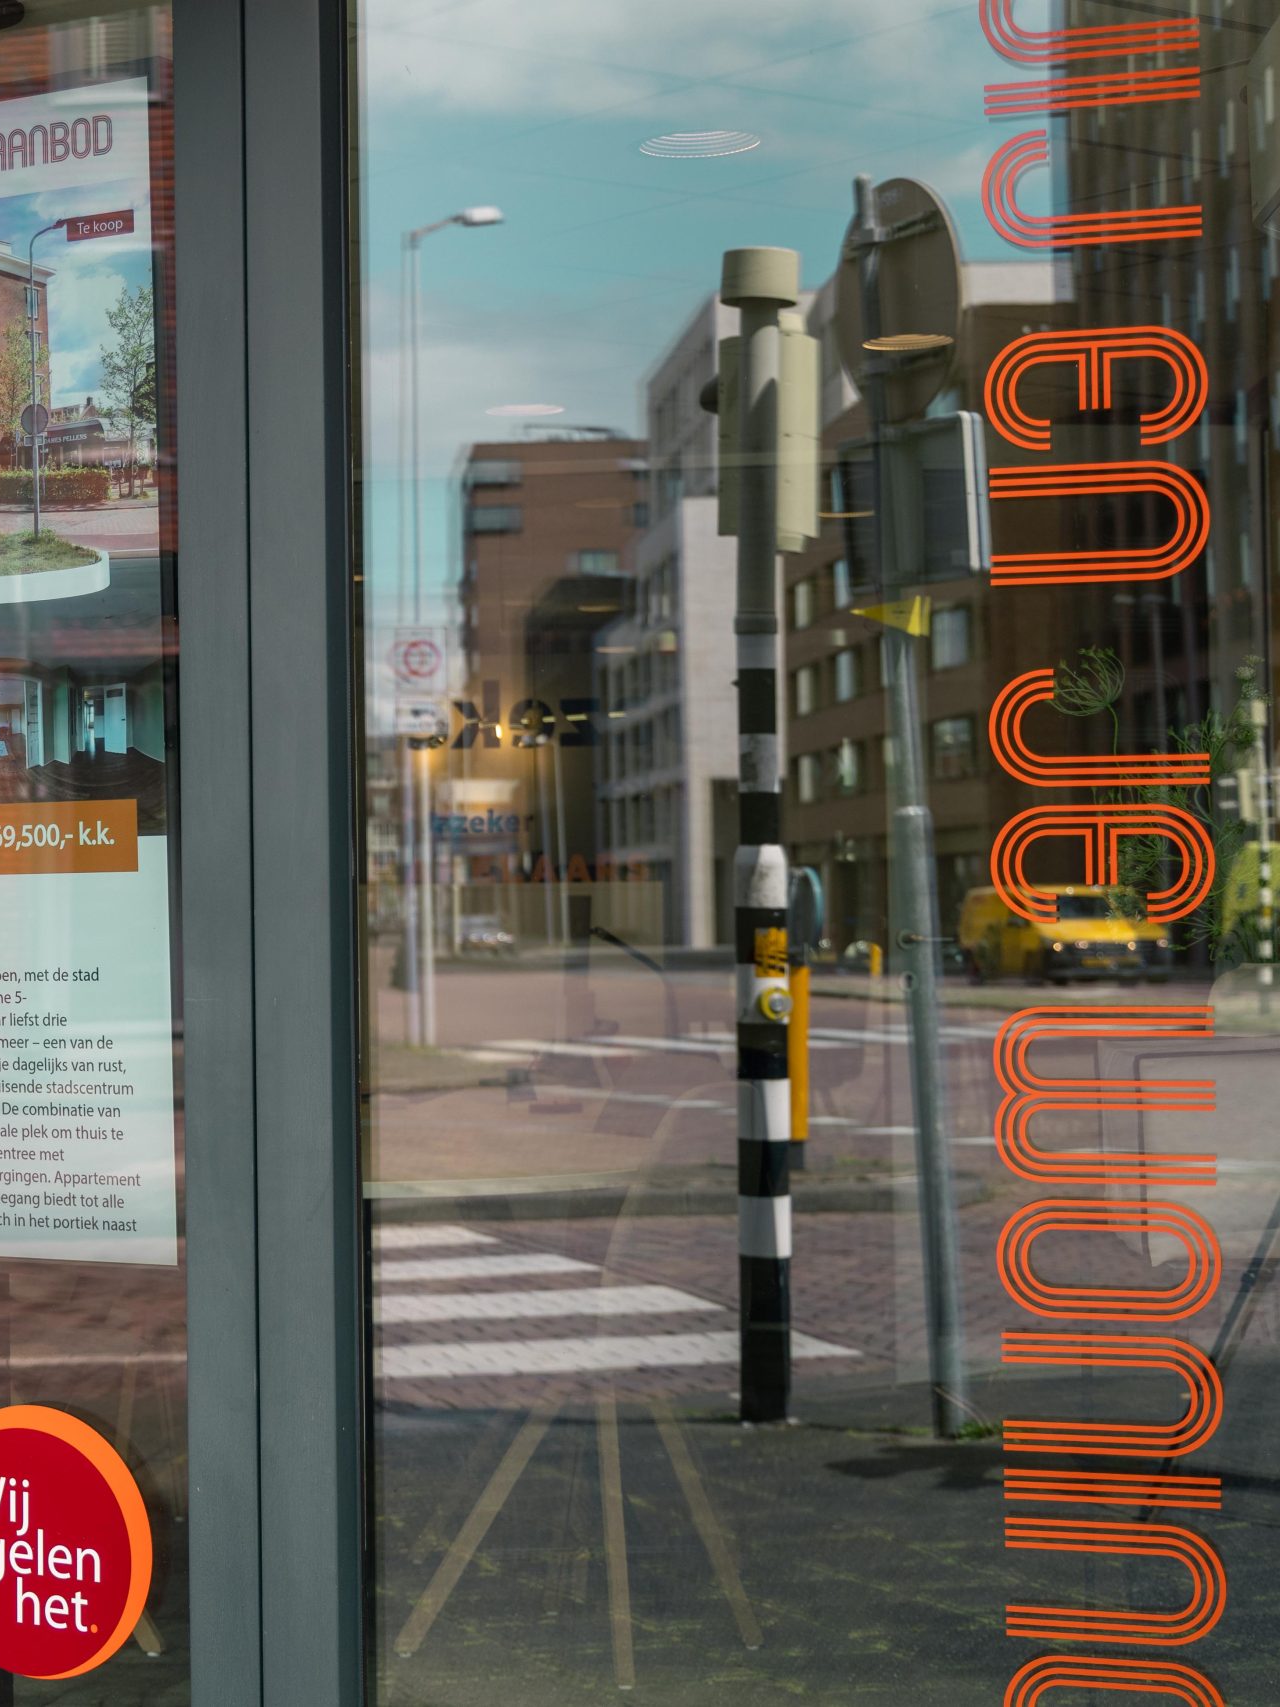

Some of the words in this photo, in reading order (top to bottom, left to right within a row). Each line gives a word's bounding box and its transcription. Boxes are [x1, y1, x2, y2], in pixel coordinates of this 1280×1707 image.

[76, 221, 90, 234] Te
[93, 218, 124, 233] koop
[984, 325, 1211, 586] EN
[988, 668, 1215, 924] JE
[78, 820, 115, 846] k.k.
[24, 969, 49, 982] met
[52, 967, 69, 982] de
[72, 967, 99, 982] stad
[14, 989, 27, 1005] 5-
[10, 1012, 40, 1027] liefst
[42, 1012, 67, 1027] drie
[43, 1038, 67, 1049] een
[69, 1038, 93, 1050] van
[96, 1034, 113, 1050] de
[12, 1056, 68, 1075] dagelijks
[71, 1061, 95, 1073] van
[98, 1059, 126, 1075] rust,
[46, 1079, 133, 1096] stadscentrum
[2, 1100, 19, 1116] De
[22, 1101, 95, 1117] combinatie
[97, 1106, 121, 1118] van
[22, 1123, 49, 1142] plek
[51, 1128, 72, 1139] om
[75, 1124, 108, 1140] thuis
[110, 1127, 124, 1141] te
[39, 1148, 65, 1162] met
[54, 1169, 141, 1190] Appartement
[44, 1191, 77, 1207] biedt
[80, 1194, 99, 1208] tot
[102, 1193, 125, 1209] alle
[29, 1212, 50, 1228] het
[102, 1217, 137, 1232] naast
[16, 1576, 98, 1634] het.
